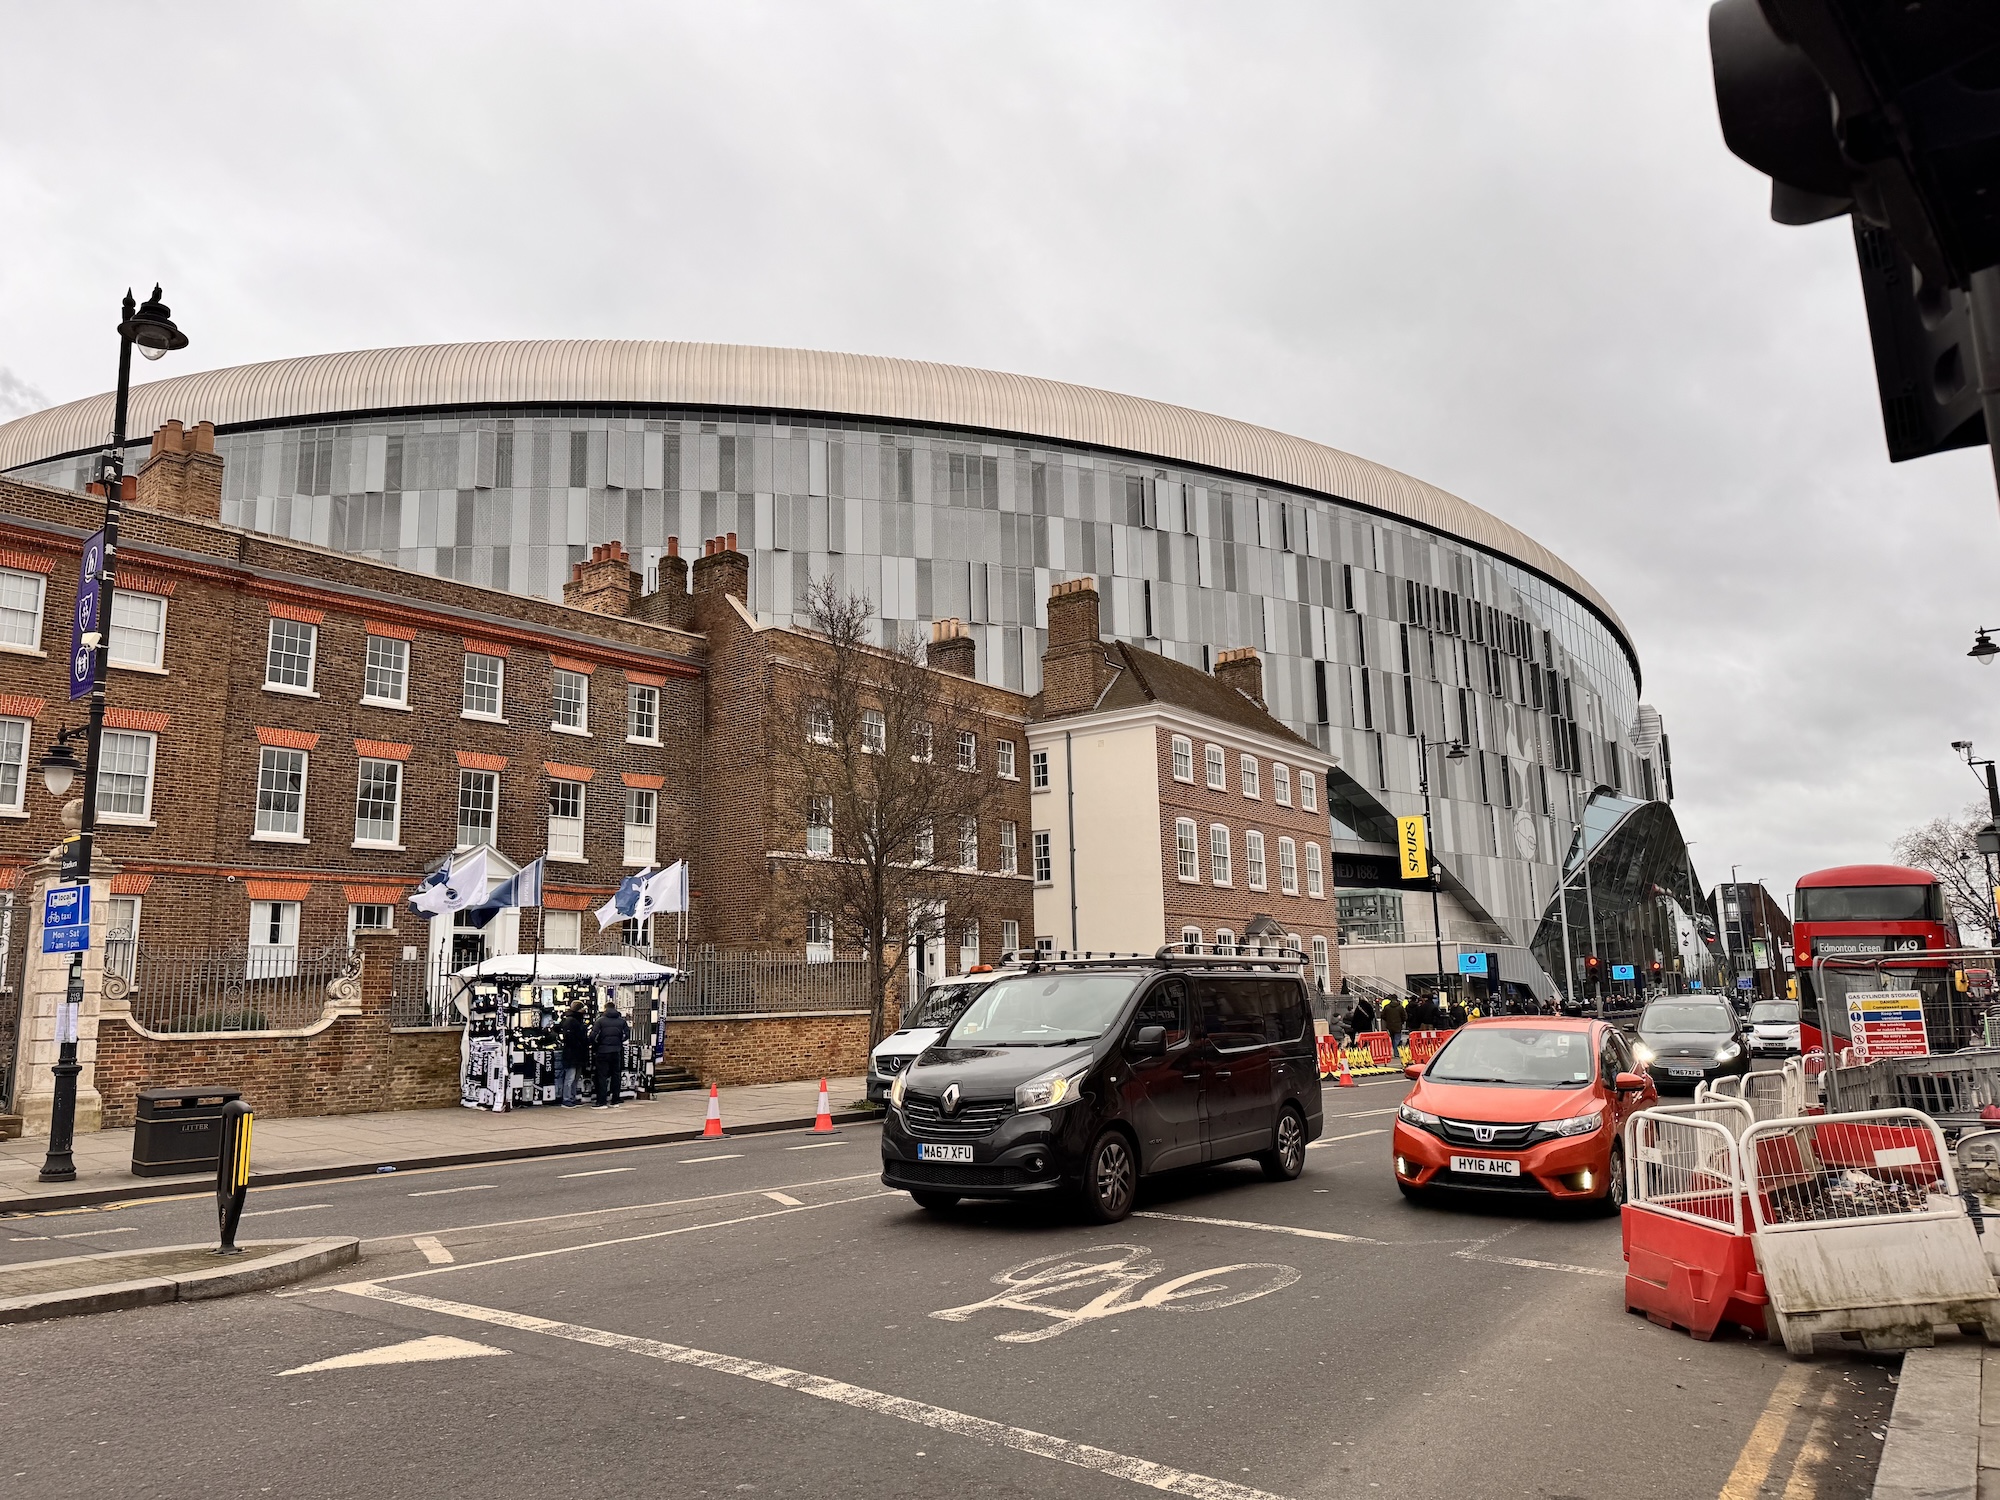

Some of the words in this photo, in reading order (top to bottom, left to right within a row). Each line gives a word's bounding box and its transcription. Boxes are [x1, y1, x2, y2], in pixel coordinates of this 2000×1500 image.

[1406, 822, 1419, 873] SPURS
[1356, 865, 1379, 880] 1882
[58, 893, 72, 901] local
[61, 912, 72, 920] taxi
[52, 931, 65, 939] Mon
[69, 930, 80, 938] Sat
[1819, 943, 1857, 953] Edmonton
[1858, 943, 1881, 953] Green
[1894, 940, 1918, 952] 149
[182, 1123, 209, 1131] LITTER
[924, 1146, 949, 1159] MA67
[951, 1147, 971, 1159] XFU
[1459, 1158, 1485, 1171] HY16
[1489, 1161, 1512, 1173] AHC
